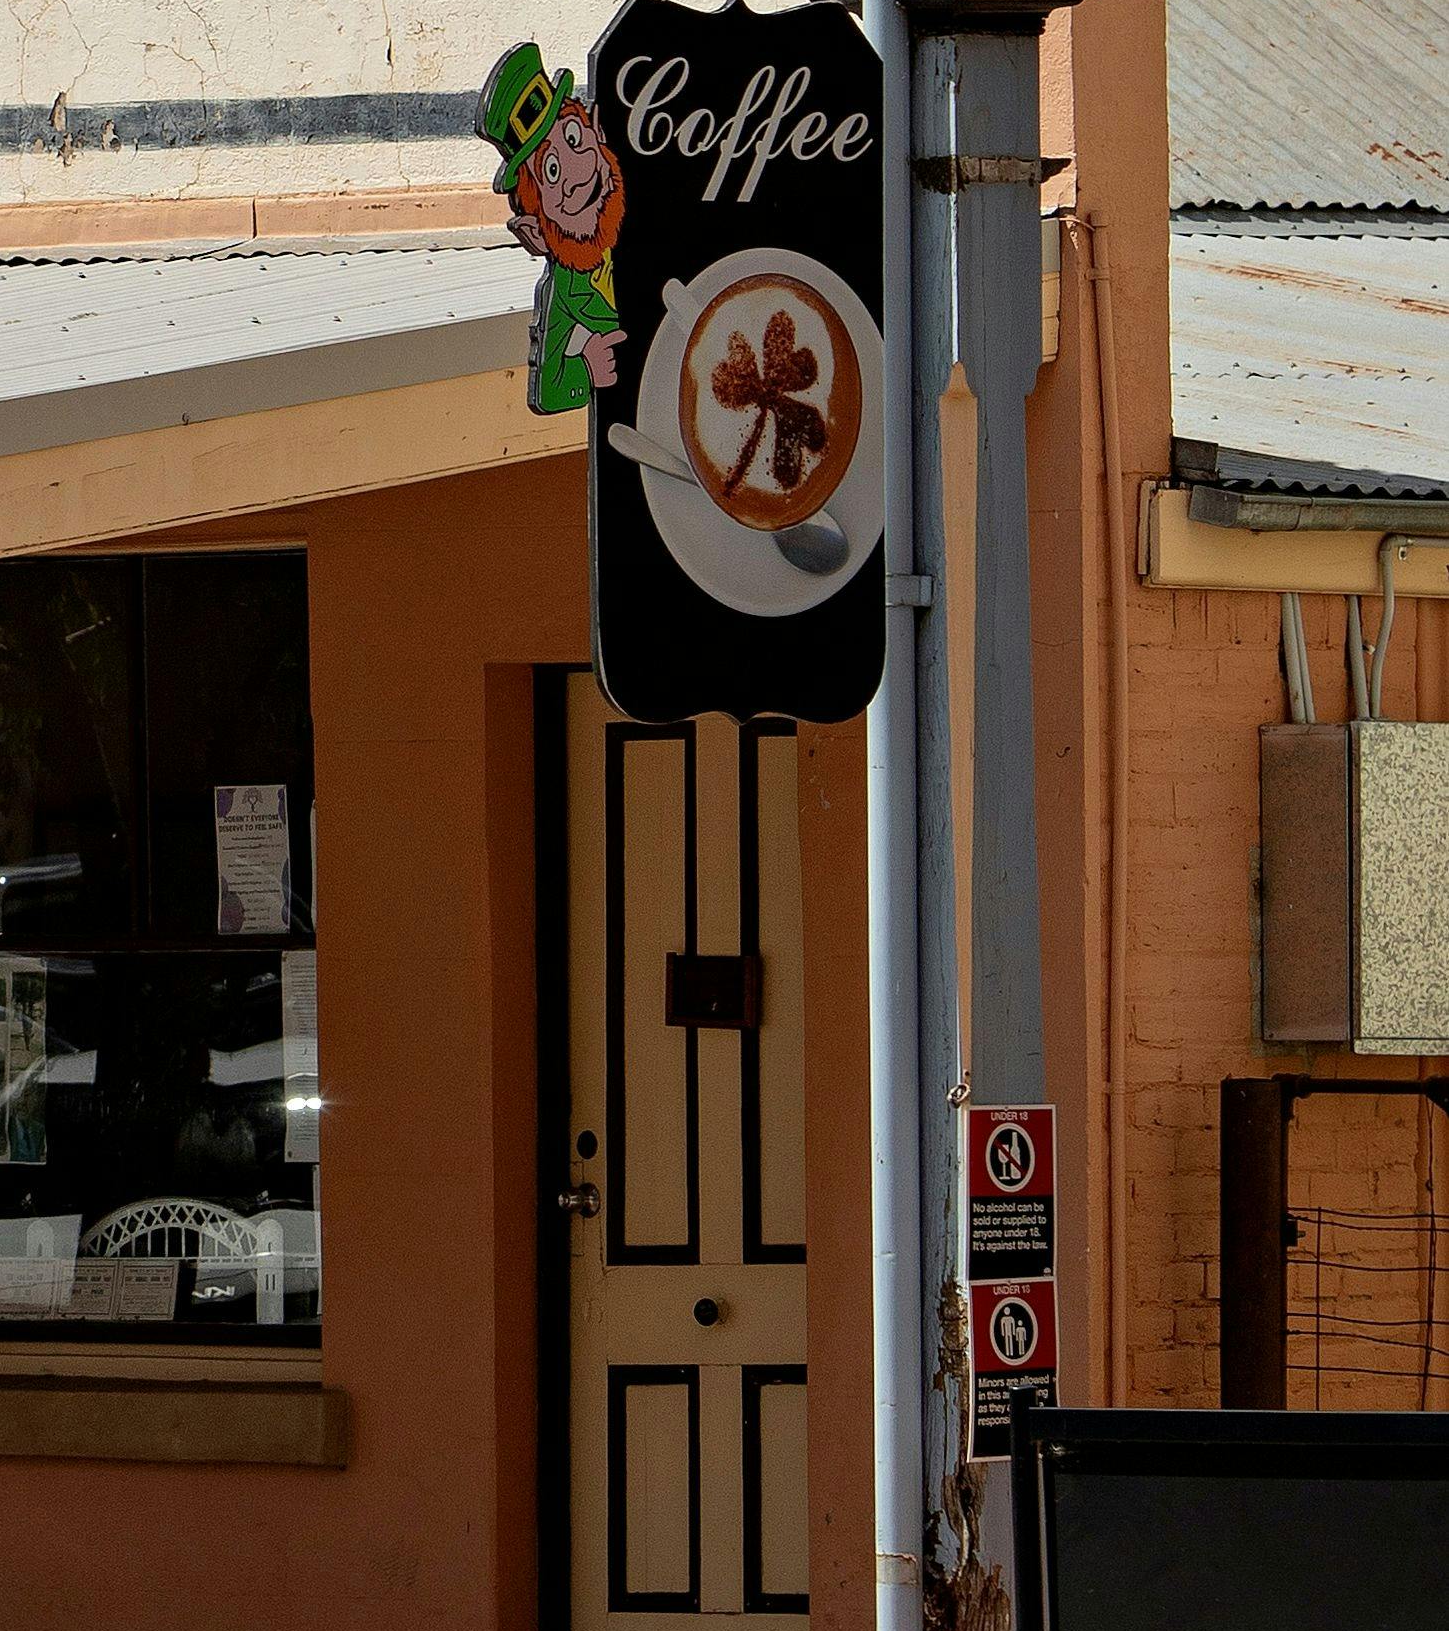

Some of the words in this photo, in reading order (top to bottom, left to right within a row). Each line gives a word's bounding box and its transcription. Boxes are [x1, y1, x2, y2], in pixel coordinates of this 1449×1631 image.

[616, 55, 873, 202] Coffee
[990, 1111, 1018, 1121] UNDER
[1019, 1111, 1028, 1121] 18
[972, 1203, 985, 1213] No
[986, 1202, 1016, 1213] alcohol
[1017, 1204, 1032, 1213] can
[1033, 1202, 1044, 1212] be
[972, 1216, 991, 1226] sold
[992, 1217, 1001, 1225] or
[1002, 1215, 1037, 1227] supplied
[1037, 1215, 1047, 1224] to
[972, 1229, 1003, 1240] anyone
[1004, 1228, 1028, 1238] under
[972, 1241, 985, 1251] It's
[986, 1240, 1016, 1253] against
[1017, 1240, 1031, 1250] the
[1032, 1240, 1048, 1250] law.
[992, 1285, 1020, 1296] UNDER
[978, 1378, 1005, 1388] Minors
[1006, 1378, 1019, 1386] are
[1020, 1375, 1050, 1386] allowed
[978, 1391, 986, 1400] in
[986, 1390, 1002, 1400] this
[978, 1405, 988, 1413] as
[989, 1403, 1006, 1414] they
